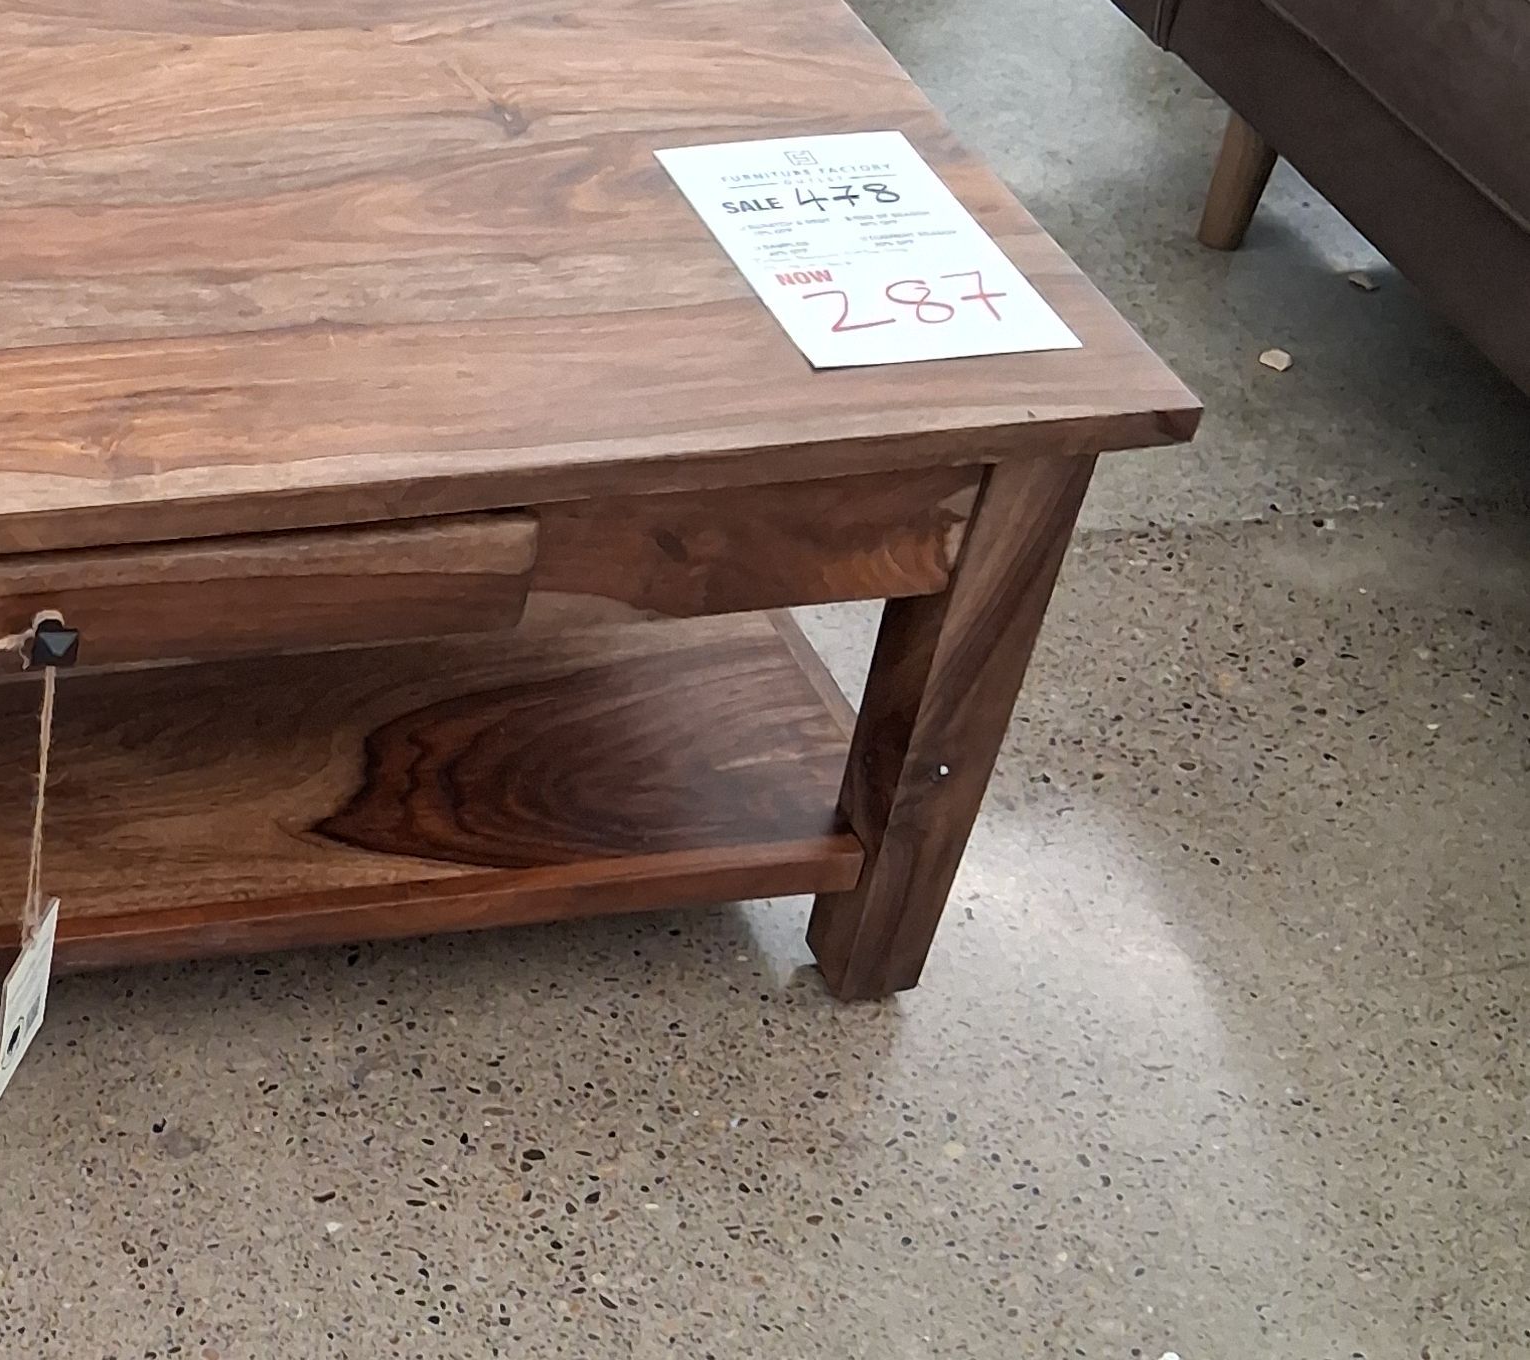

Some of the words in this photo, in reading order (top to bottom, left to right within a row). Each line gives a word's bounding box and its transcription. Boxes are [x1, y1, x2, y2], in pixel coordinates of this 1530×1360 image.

[819, 163, 892, 175] FACTORY
[722, 197, 785, 214] SALE
[794, 183, 901, 212] 478
[775, 269, 834, 286] NOW
[802, 270, 1007, 332] 287
